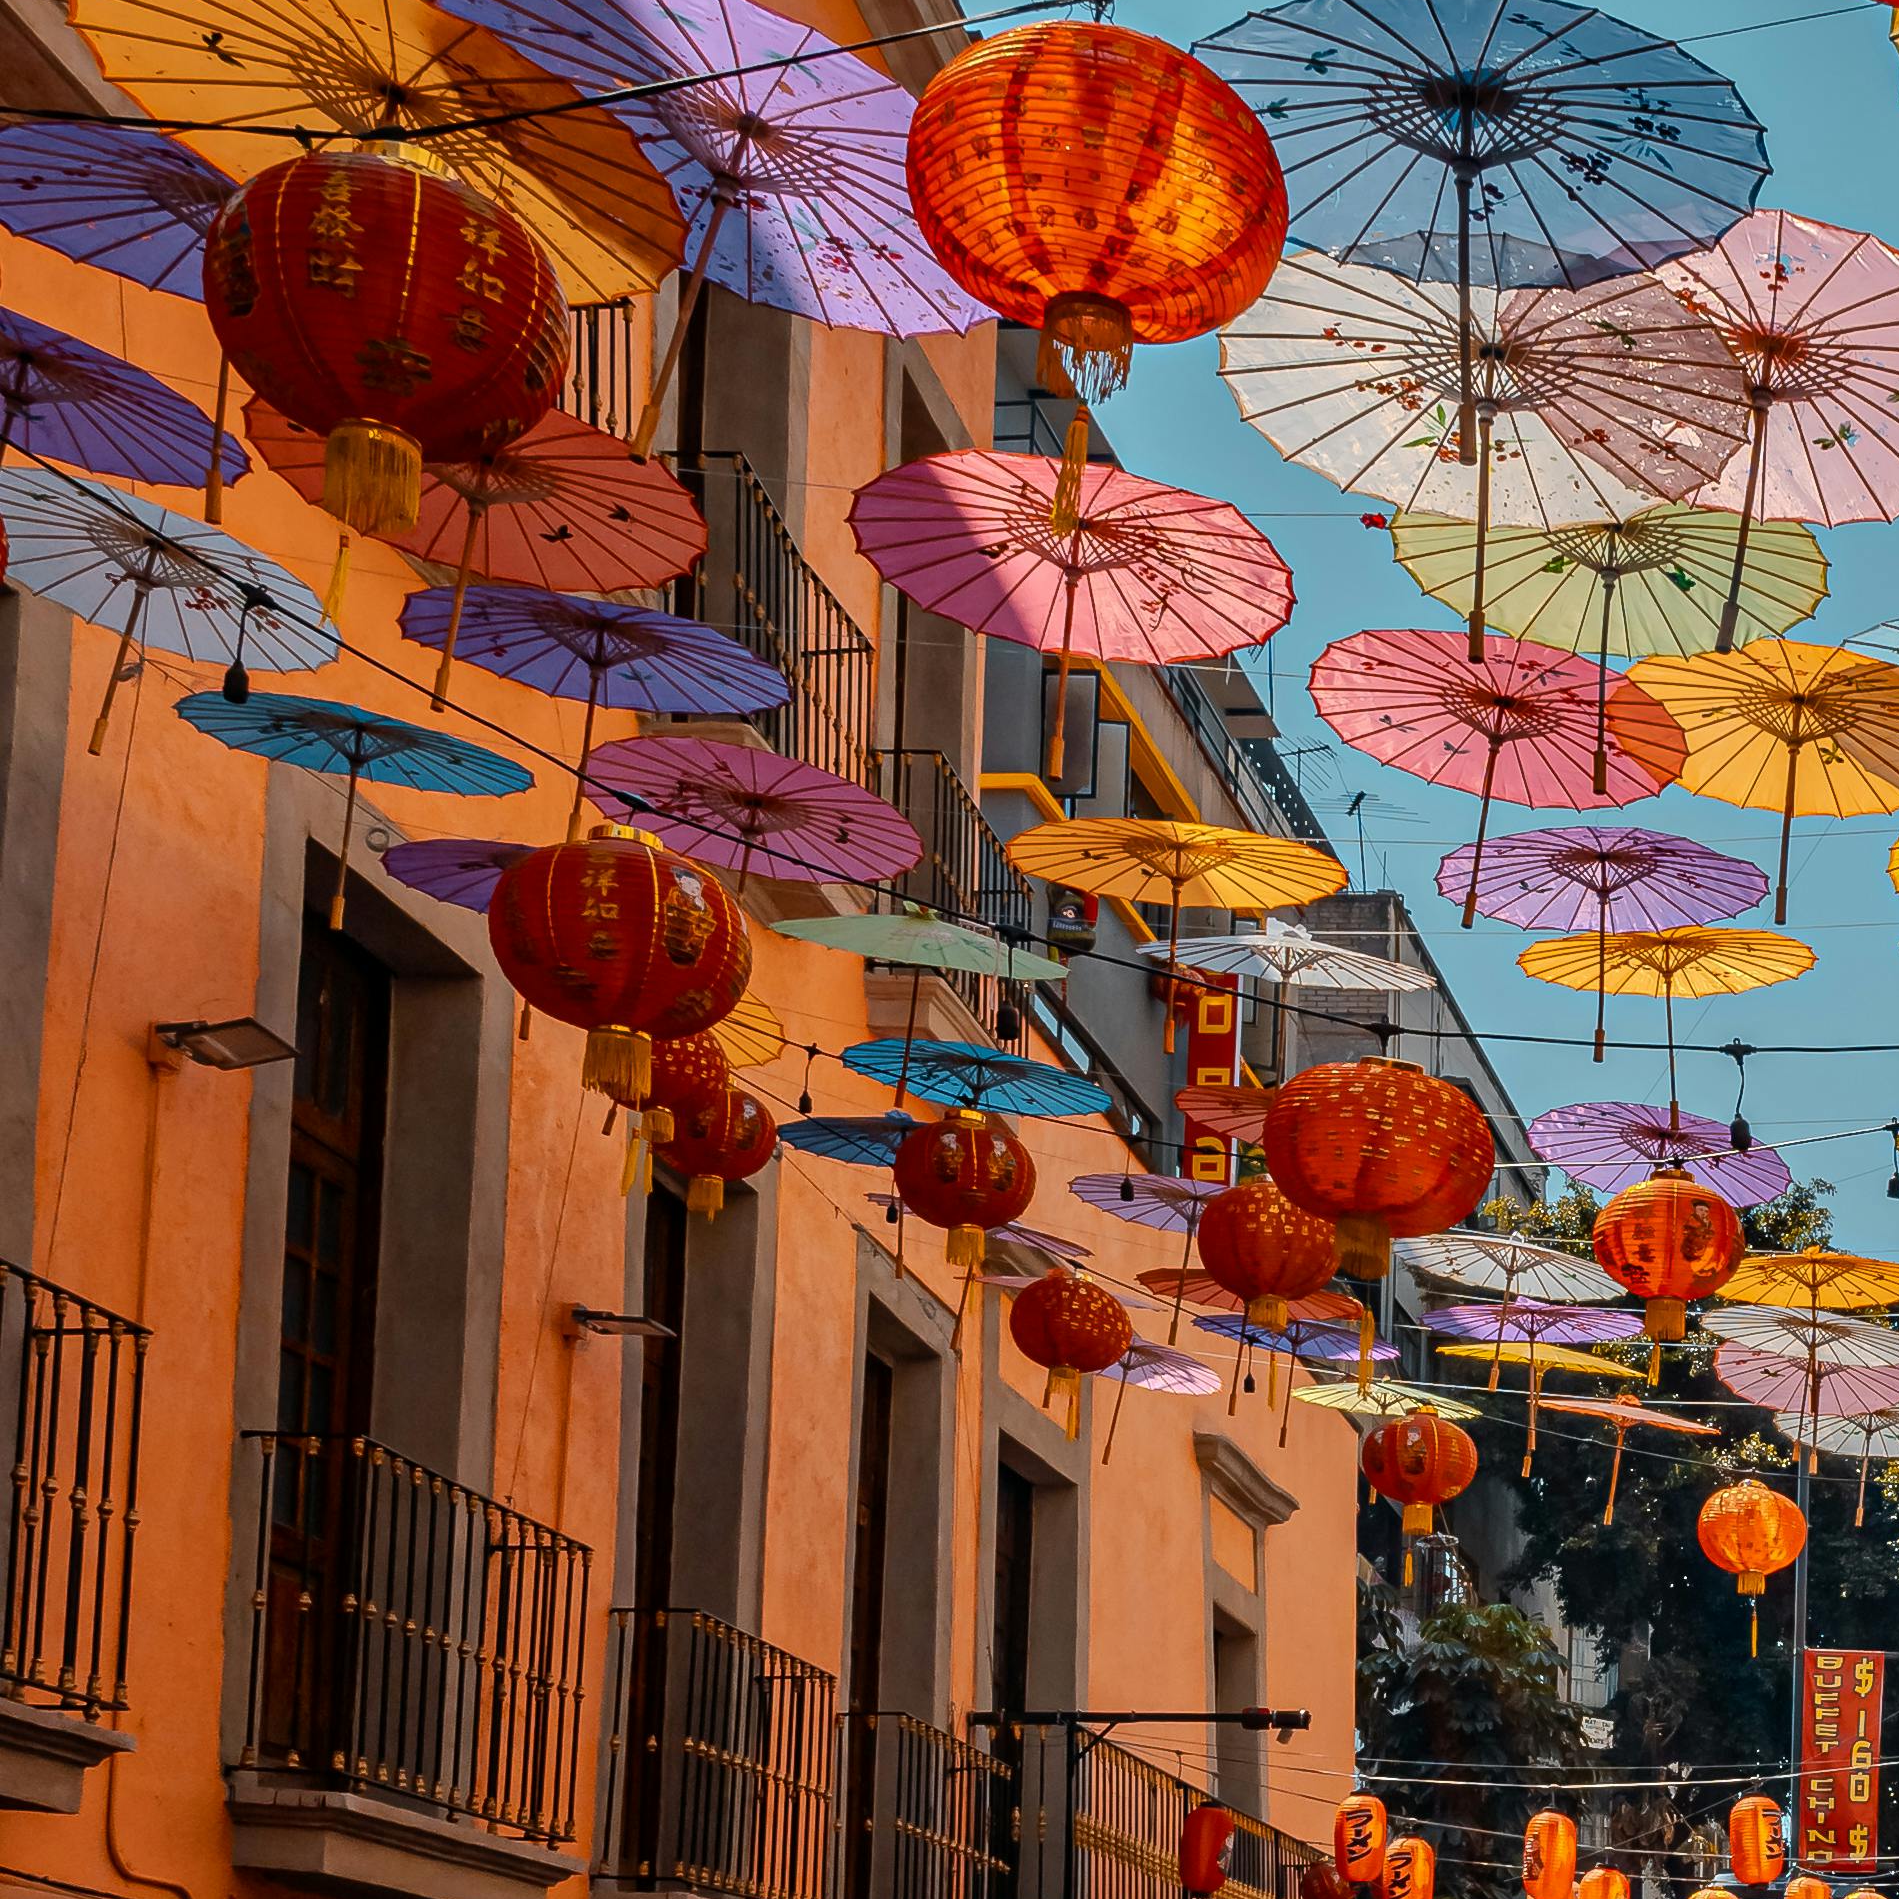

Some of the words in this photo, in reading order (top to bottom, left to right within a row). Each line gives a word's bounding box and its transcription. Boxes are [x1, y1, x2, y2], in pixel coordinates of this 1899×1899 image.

[1813, 1655, 1844, 1753] BUFFET
[1345, 1808, 1373, 1864] ラーメン
[1806, 1777, 1837, 1864] CHINO
